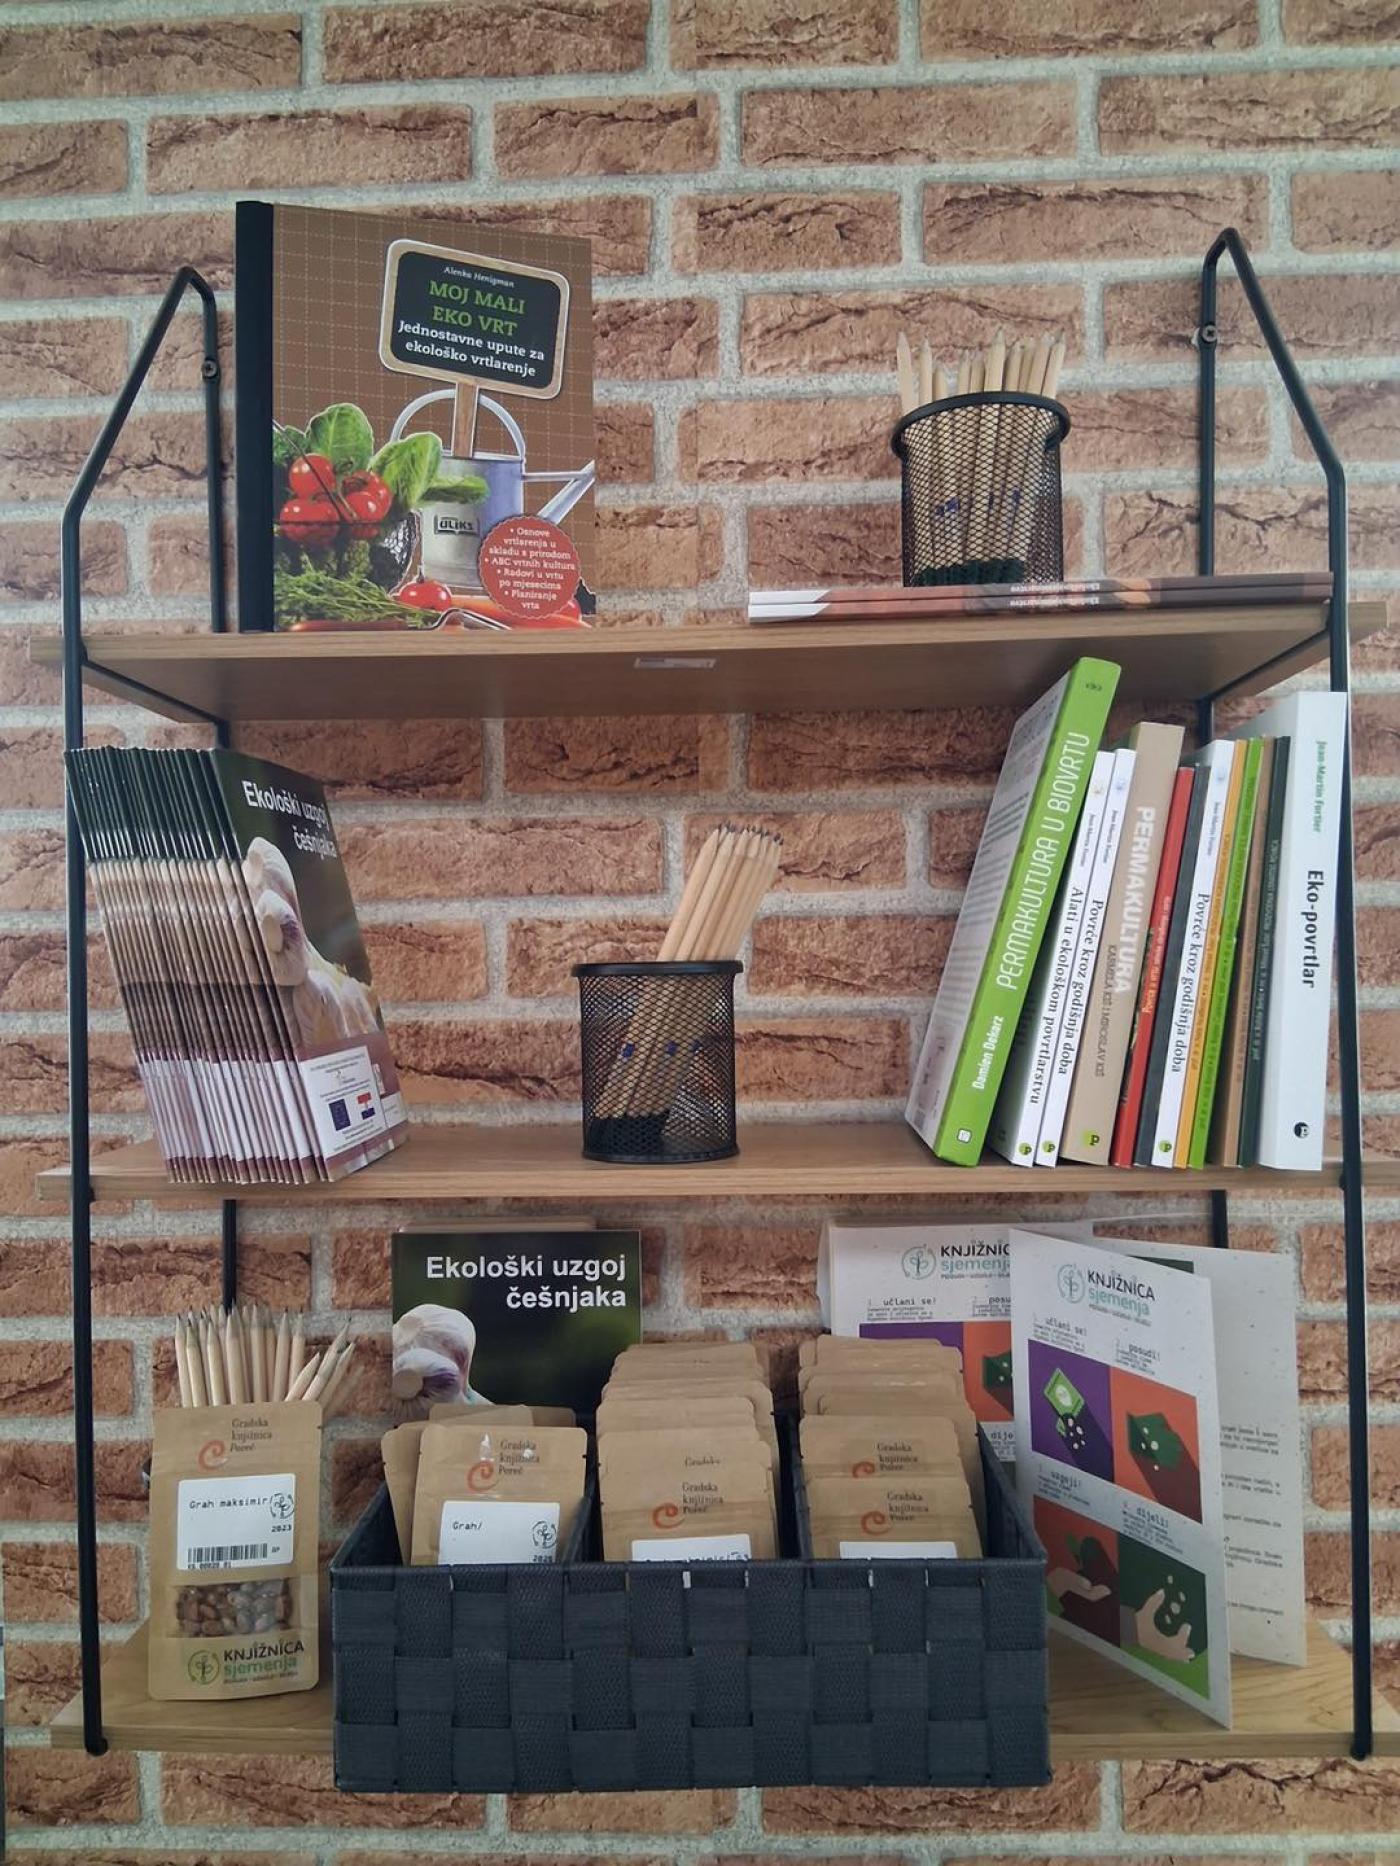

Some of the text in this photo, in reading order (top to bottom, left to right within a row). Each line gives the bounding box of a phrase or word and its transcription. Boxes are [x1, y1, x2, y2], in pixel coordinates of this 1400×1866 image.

[429, 280, 525, 314] MOJ MALI
[433, 306, 517, 336] EKO VRT
[398, 320, 544, 360] Jednostavne upute za
[405, 340, 535, 377] ekološko vrtlarenje
[242, 780, 302, 817] Ekološki
[1313, 741, 1326, 833] Jean-Martin Fortier
[996, 731, 1090, 991] PERMAKULTURA U BIOVRTU
[1115, 806, 1156, 994] PERMAKULTURA
[1301, 870, 1324, 988] Eko-povrtlar
[1030, 887, 1084, 1104] Alati u ekološkom povrtlarstvu
[1058, 899, 1104, 1075] Povrće kroz godišnja doba
[1171, 893, 1210, 1073] Povrće kroz godišnja doba
[972, 1052, 994, 1089] Damien
[940, 1239, 1011, 1258] KNJIŽNIC
[940, 1255, 1010, 1273] sjemenj
[427, 1254, 626, 1281] Ekološki uzgoj
[1087, 1269, 1156, 1301] KNJIŽNICA
[506, 1285, 627, 1313] češnjaka
[988, 1296, 1011, 1305] posu
[1088, 1287, 1150, 1317] sjemenja
[189, 1497, 268, 1509] Grah maksimir
[223, 1639, 304, 1662] KNJIŽNICA
